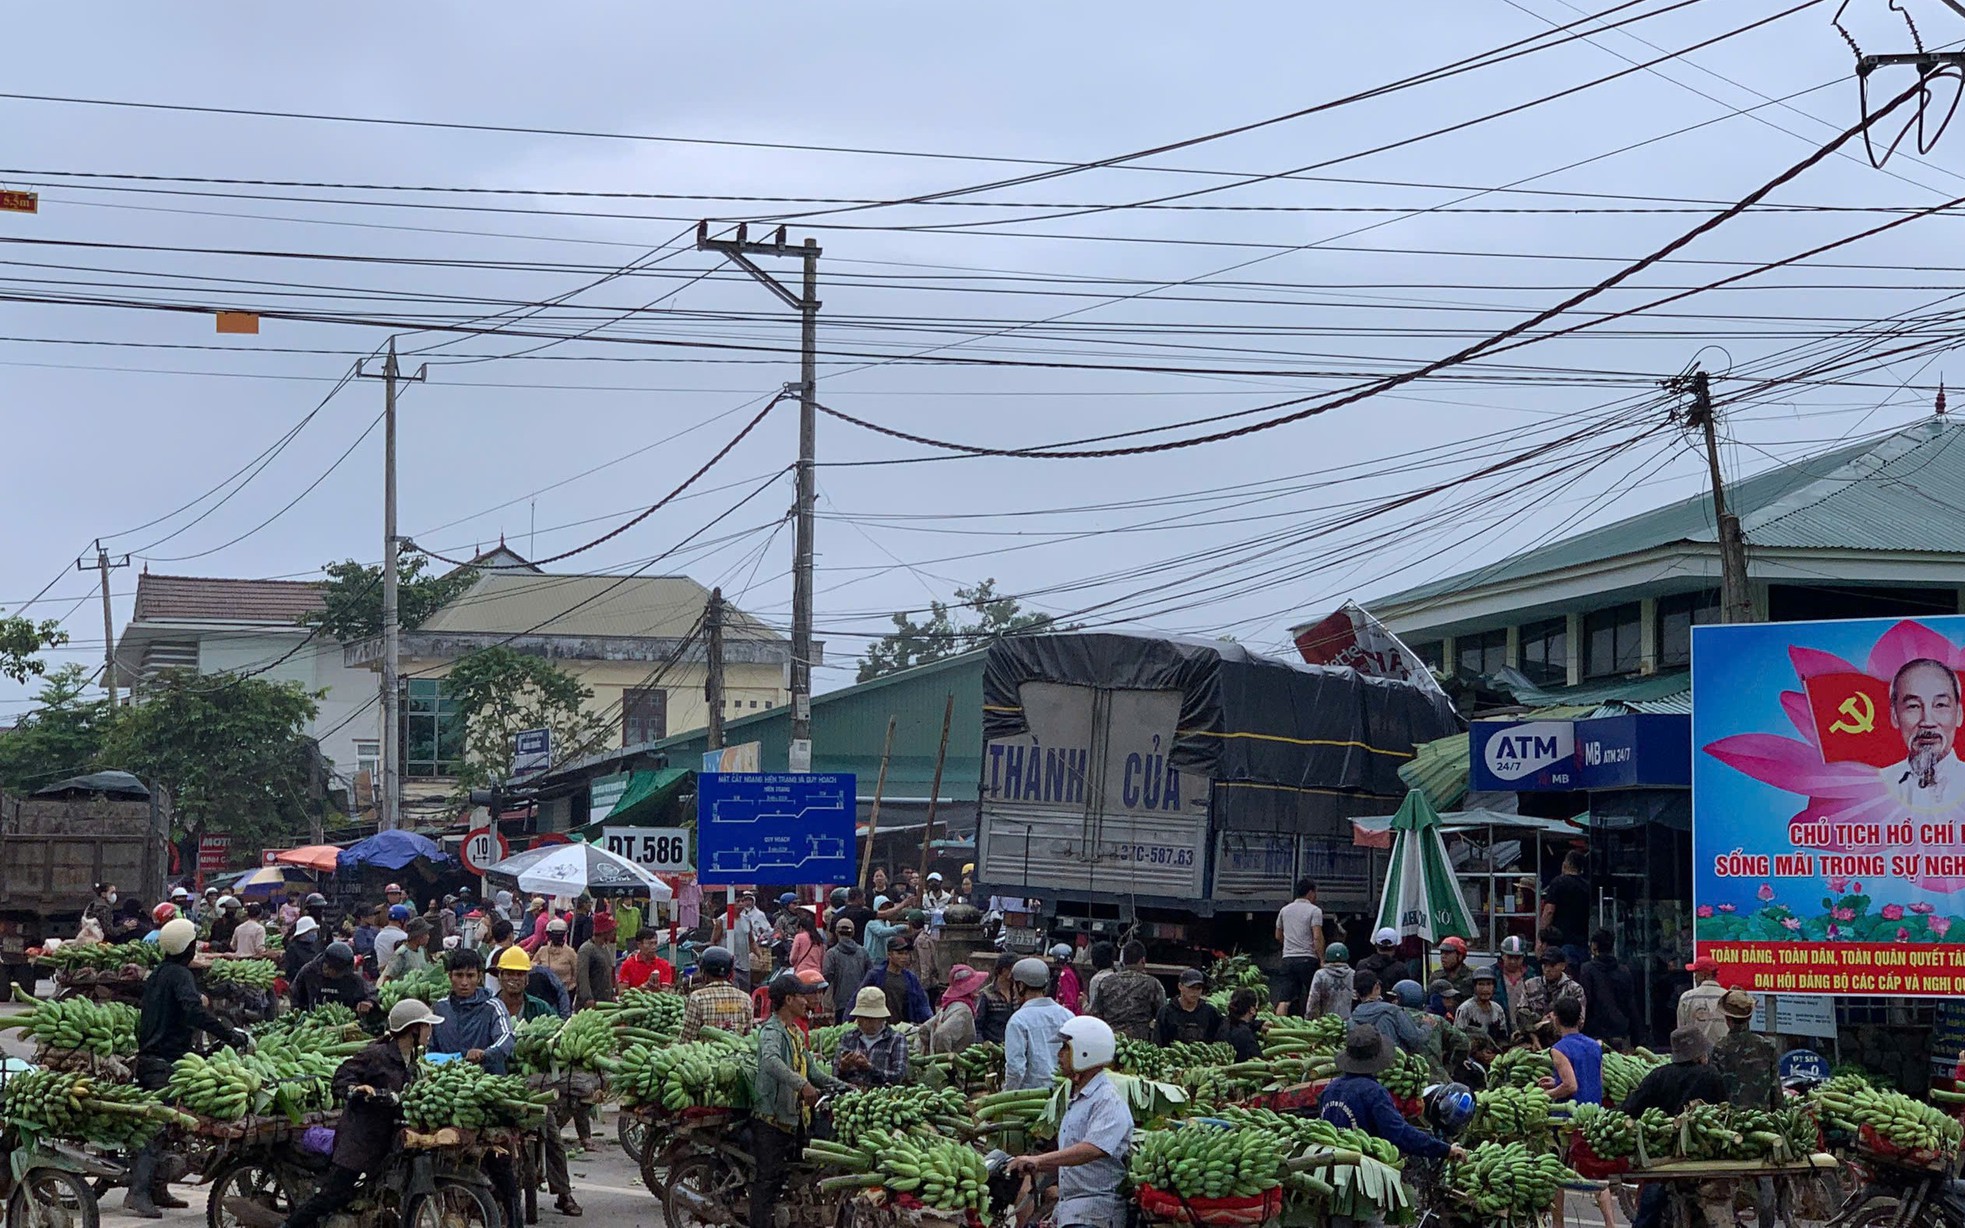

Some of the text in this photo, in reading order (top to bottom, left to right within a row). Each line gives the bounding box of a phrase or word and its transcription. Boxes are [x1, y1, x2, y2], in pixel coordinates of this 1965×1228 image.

[1496, 736, 1557, 760] ATM
[1585, 741, 1631, 766] MB ATM 24/7
[1122, 734, 1181, 811] CỦA
[1496, 762, 1521, 771] 24/7
[1552, 774, 1570, 784] MB
[1790, 818, 1830, 845] CHỦ
[1836, 824, 1880, 848] TỊCH
[1886, 817, 1913, 844] HỒ
[1920, 820, 1954, 844] CHÍ
[476, 837, 488, 855] 10
[608, 835, 684, 864] ĐT.586
[1716, 848, 1769, 876] SỐNG
[1775, 852, 1812, 875] MÃI
[1819, 856, 1885, 876] TRONG
[1892, 854, 1921, 880] SỰ
[1710, 946, 1739, 963] TOÀN
[1742, 945, 1776, 965] ĐẢNG,
[1778, 947, 1808, 964] TOÀN
[1811, 947, 1839, 966] DÂN,
[1841, 948, 1871, 965] TOÀN
[1874, 948, 1906, 967] QUÂN
[1909, 947, 1945, 967] QUYẾT
[1754, 973, 1774, 991] ĐẠI
[1777, 971, 1796, 991] HỘI
[1799, 970, 1831, 989] ĐẢNG
[1833, 972, 1849, 992] BỘ
[1852, 972, 1875, 989] CÁC
[1878, 971, 1902, 990] CẤP
[1904, 973, 1920, 991] VÀ
[1923, 976, 1951, 994] NGHỊ
